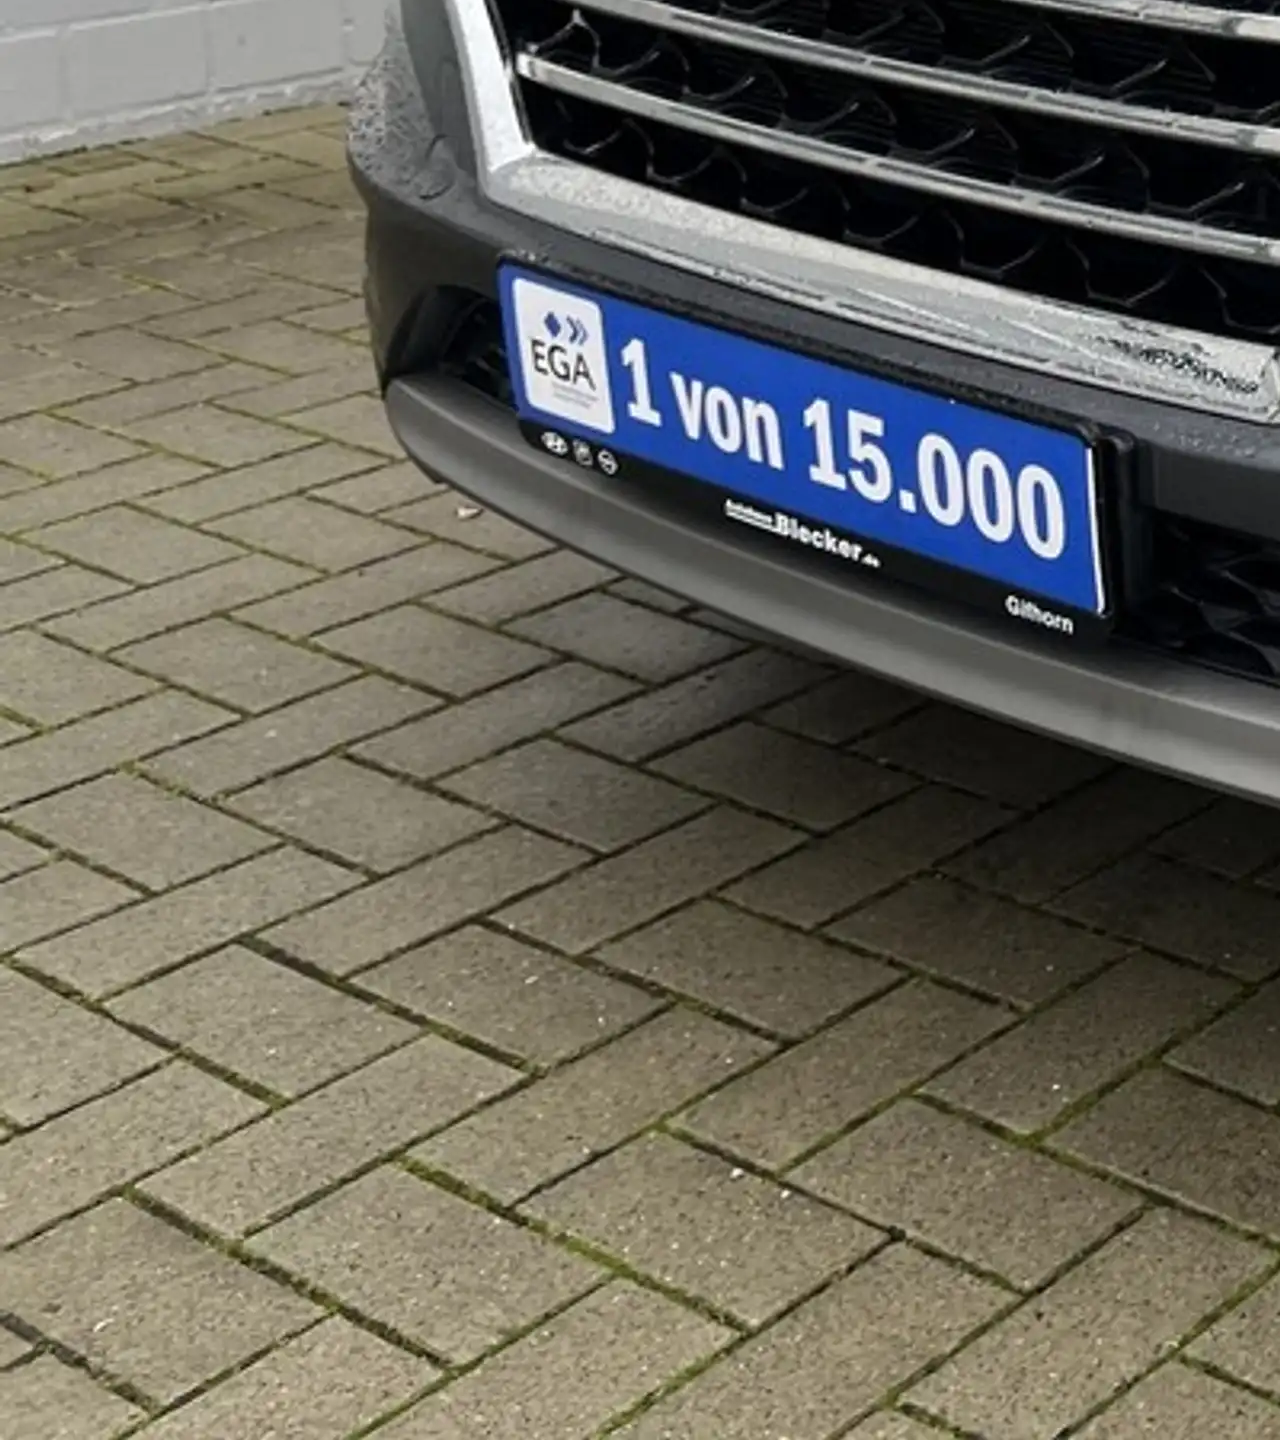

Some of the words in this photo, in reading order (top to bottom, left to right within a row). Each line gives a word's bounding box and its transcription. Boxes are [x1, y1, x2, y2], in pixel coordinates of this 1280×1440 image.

[531, 338, 597, 391] EGA
[621, 338, 661, 427] 1
[670, 371, 783, 470] von
[803, 398, 1065, 560] 15.000
